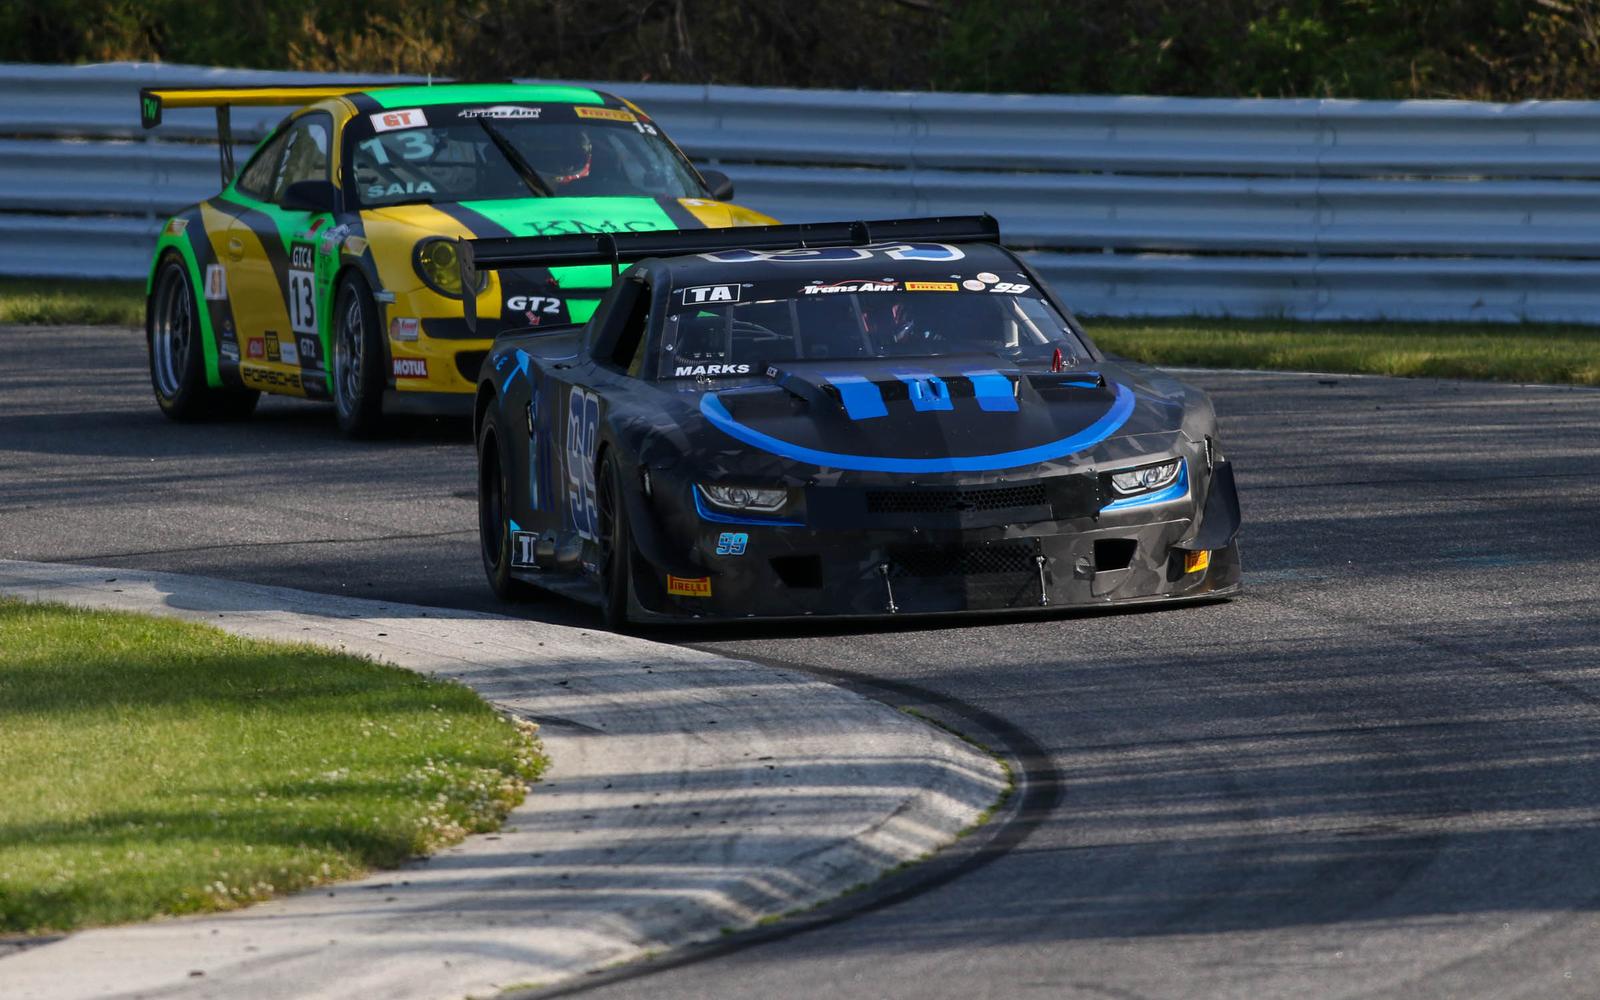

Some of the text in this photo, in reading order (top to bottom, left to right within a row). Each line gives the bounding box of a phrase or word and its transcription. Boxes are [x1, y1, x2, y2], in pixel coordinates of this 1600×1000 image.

[383, 112, 411, 127] GT
[633, 121, 658, 136] 13
[360, 131, 434, 165] 13
[367, 181, 437, 198] SAIA
[293, 246, 311, 268] GTC4
[691, 286, 732, 302] TA
[804, 285, 858, 294] Trans
[989, 282, 1031, 294] 99
[291, 275, 314, 327] 13
[507, 295, 561, 314] GT2
[393, 359, 427, 376] MOTUL
[675, 364, 750, 377] MARKS
[566, 385, 600, 544] 99
[716, 532, 749, 555] 99
